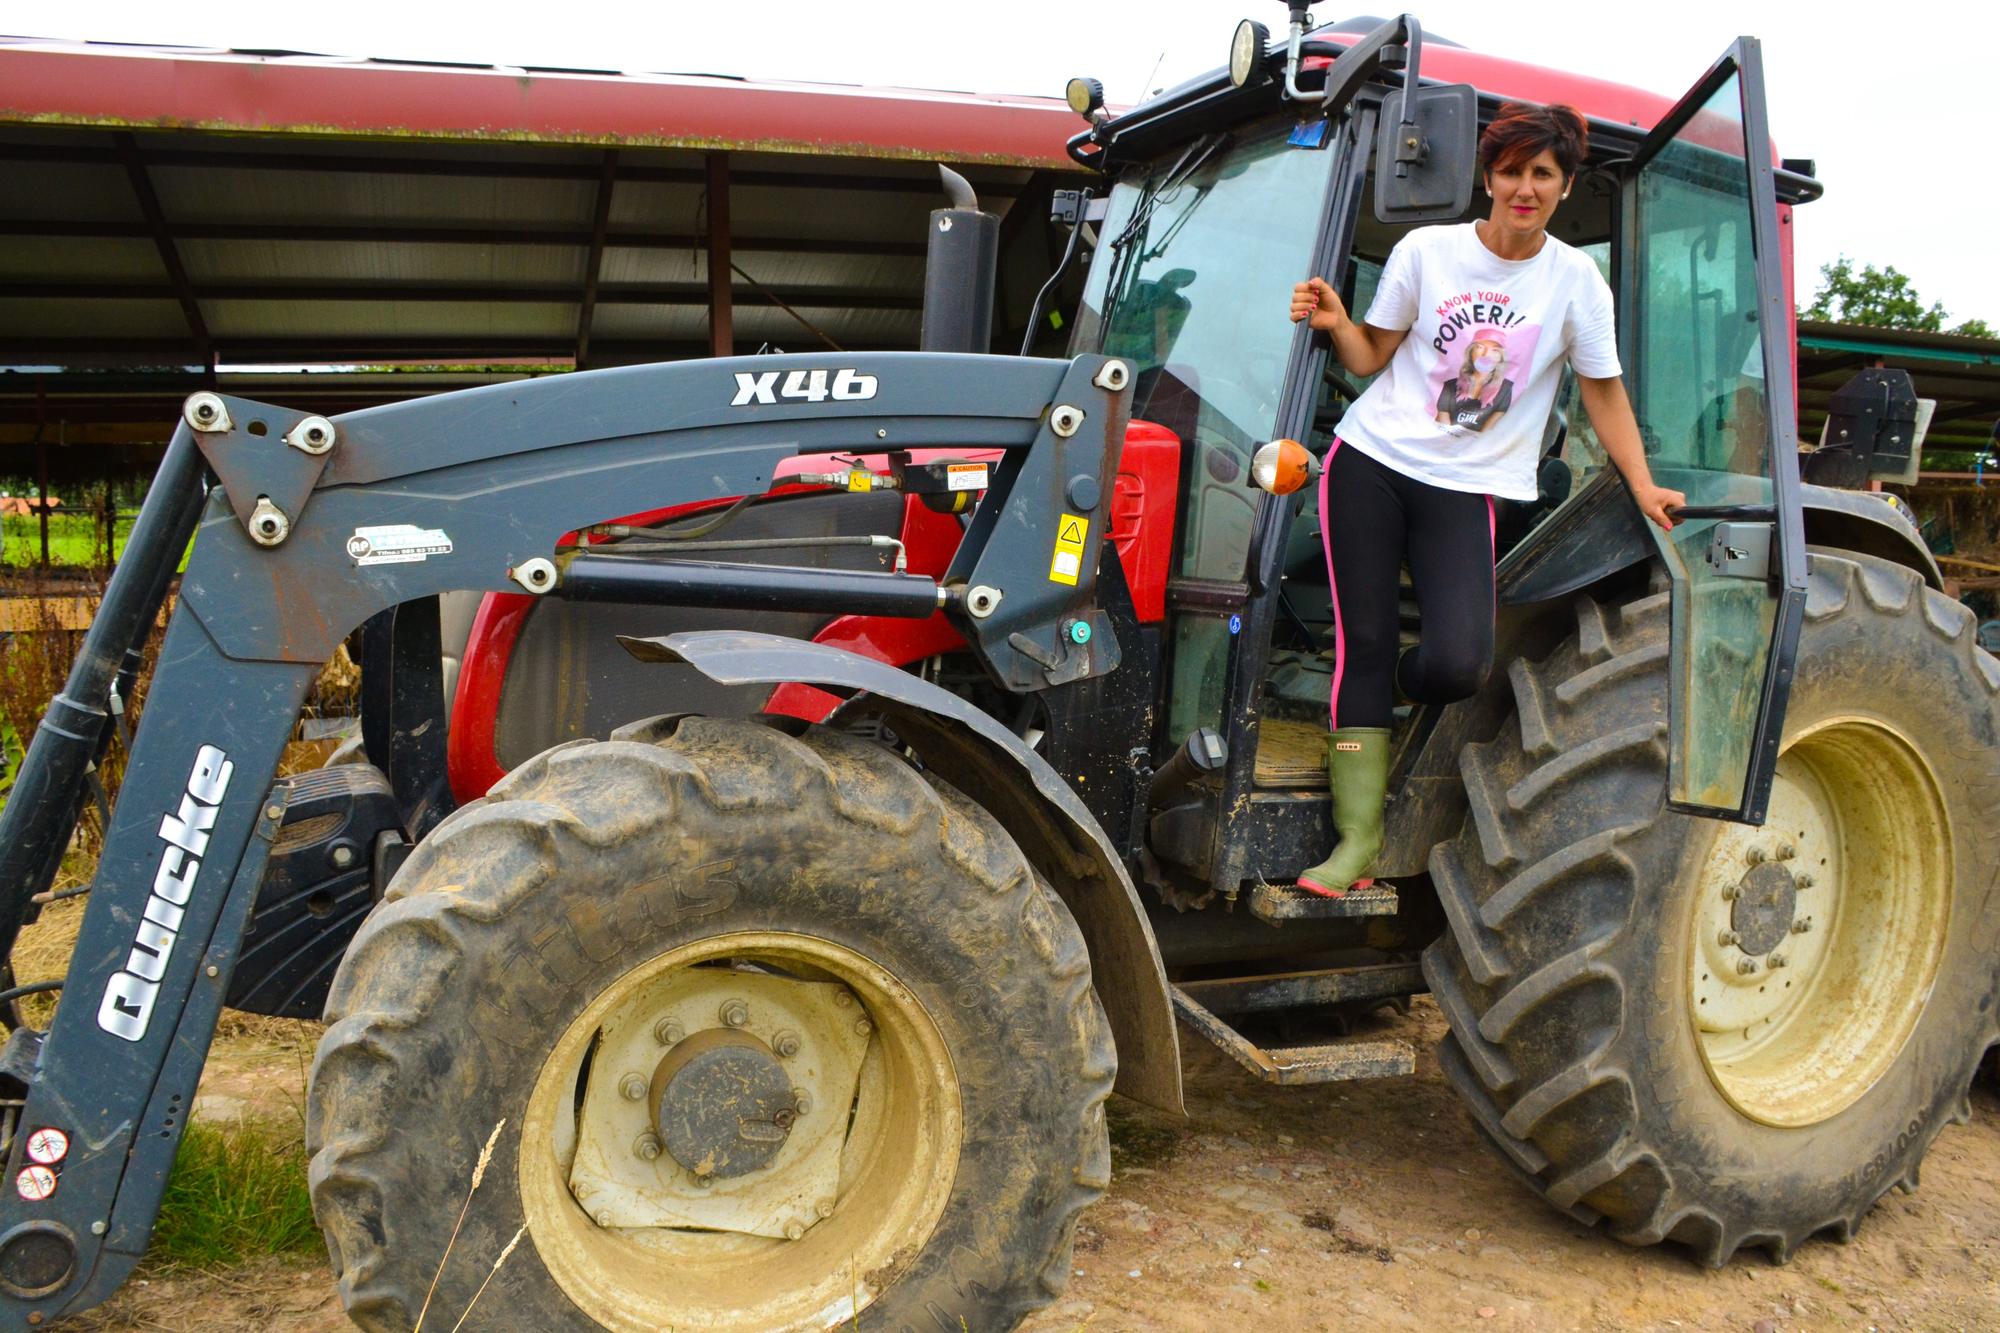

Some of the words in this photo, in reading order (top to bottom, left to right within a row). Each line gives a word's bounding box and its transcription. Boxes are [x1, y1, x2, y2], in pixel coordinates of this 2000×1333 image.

[1436, 292, 1472, 316] KNOW
[1477, 291, 1510, 306] YOUR
[1433, 304, 1526, 355] POWER!!
[730, 368, 878, 406] X46
[1457, 412, 1479, 425] GIRL
[97, 744, 235, 1042] Quicke
